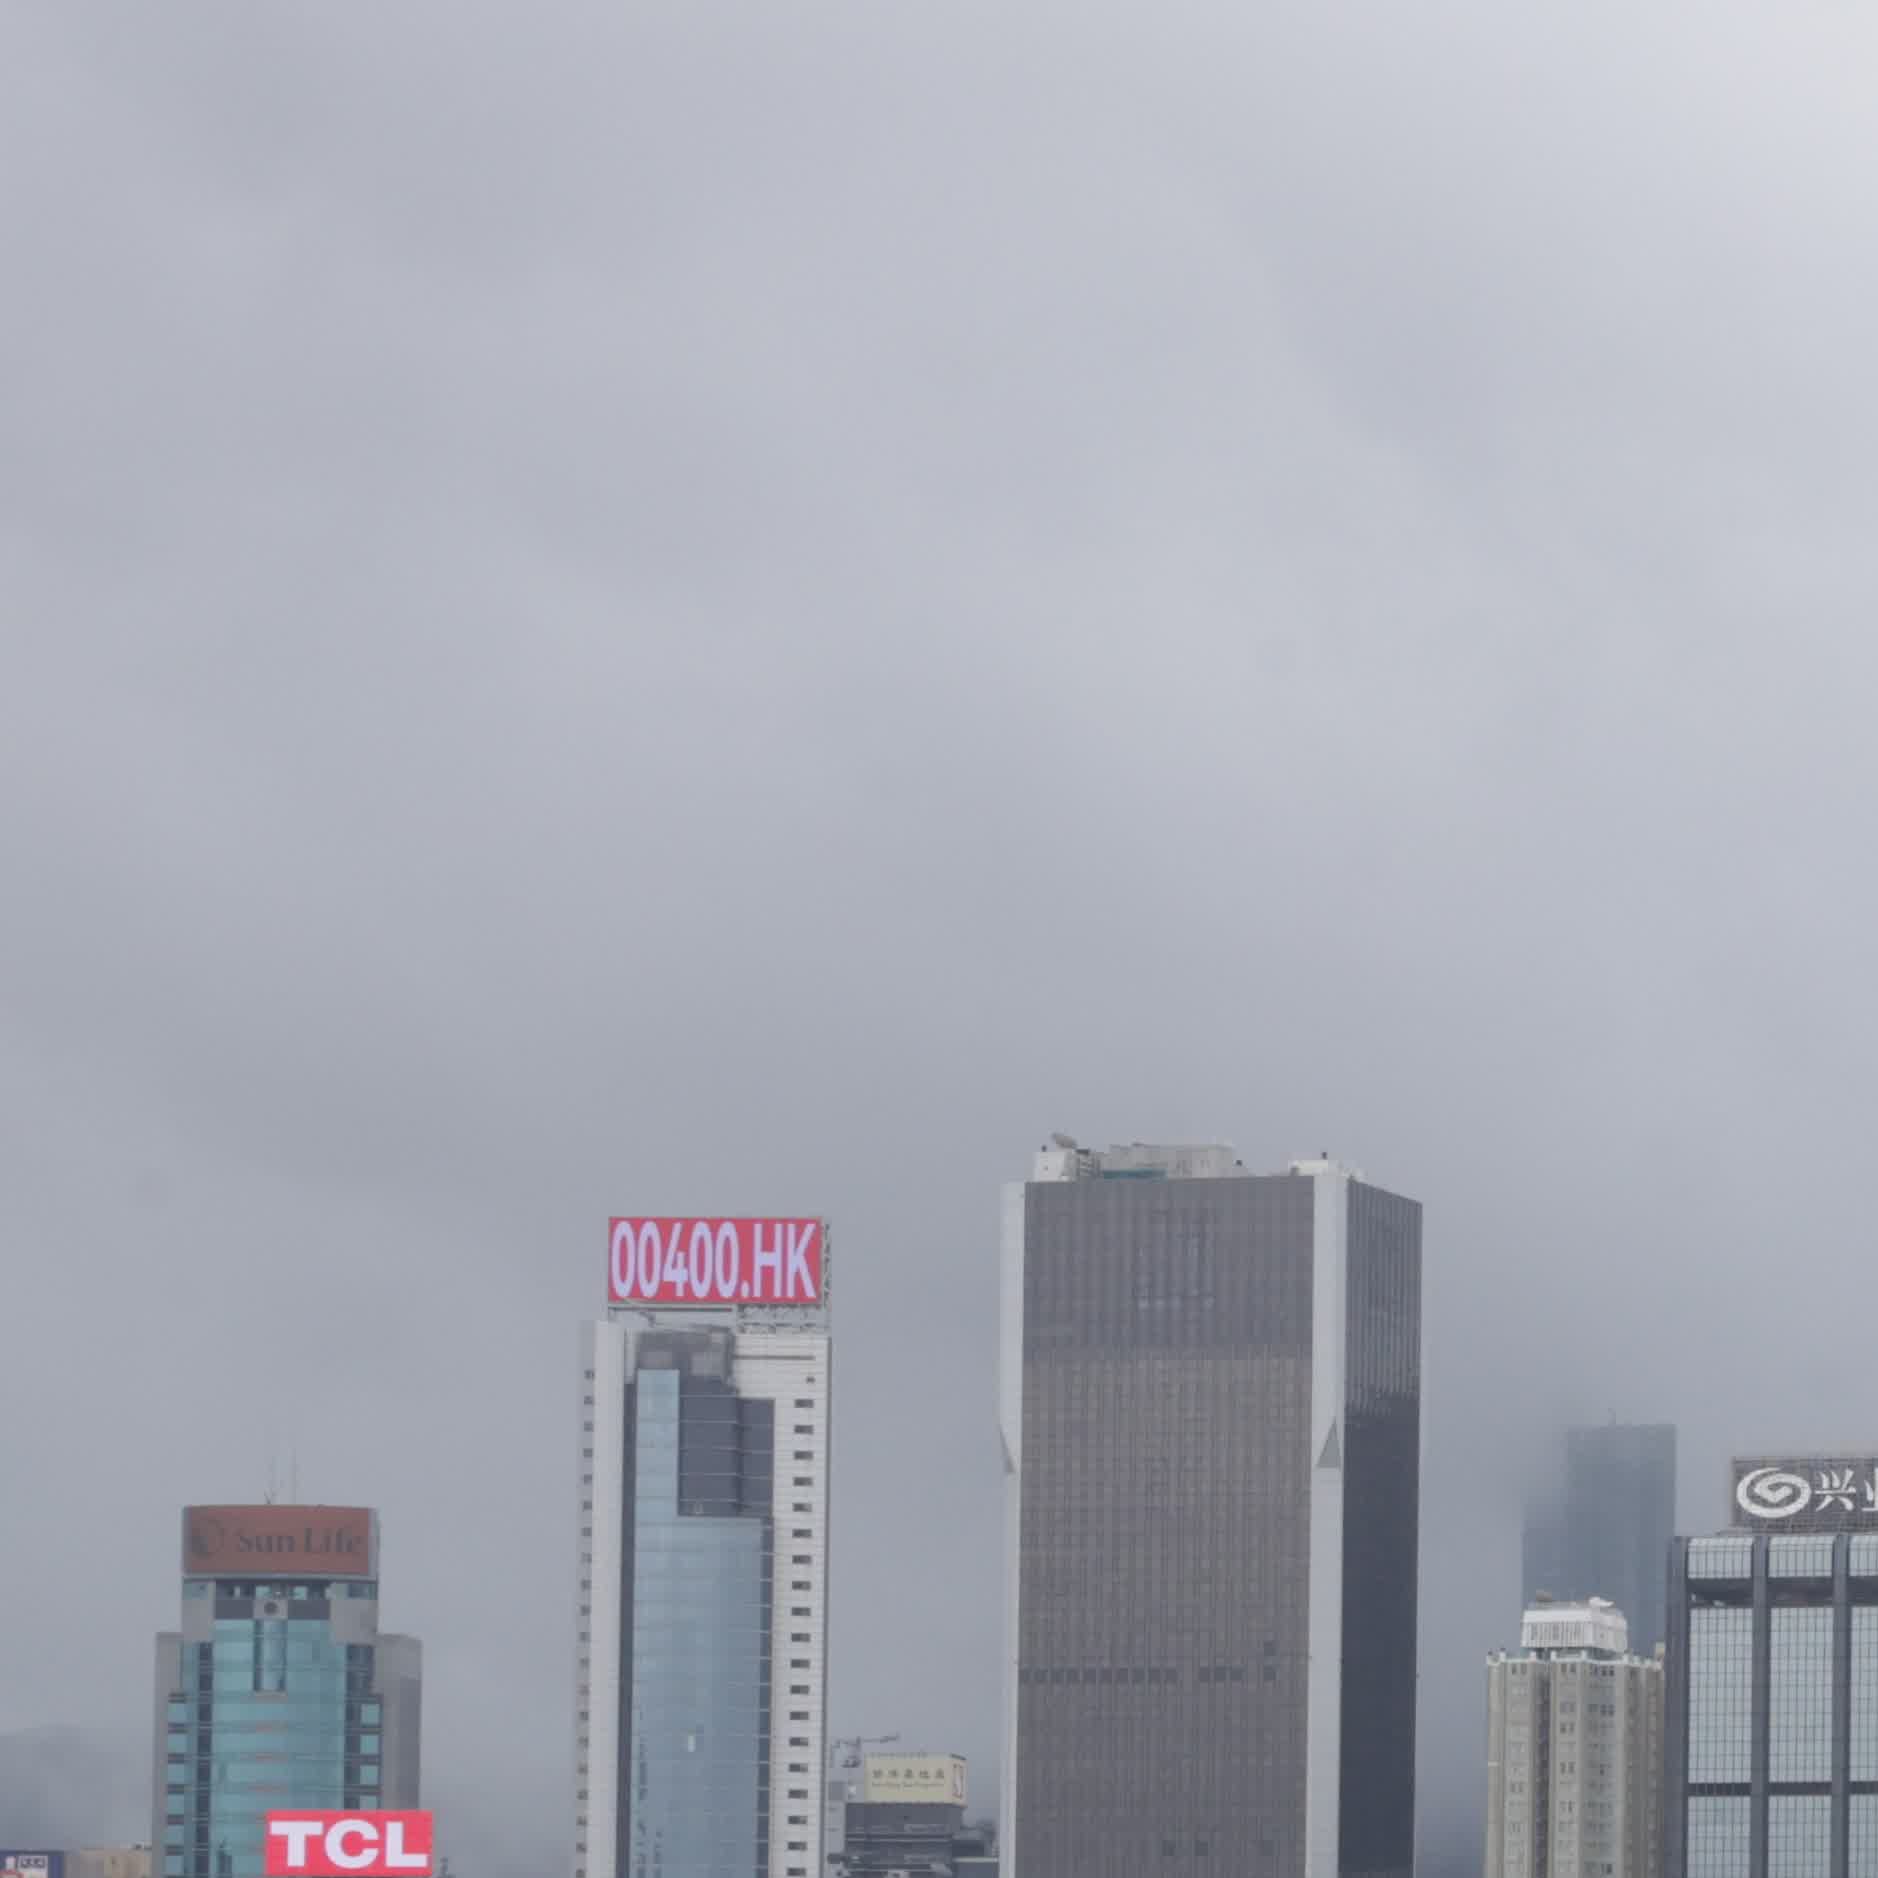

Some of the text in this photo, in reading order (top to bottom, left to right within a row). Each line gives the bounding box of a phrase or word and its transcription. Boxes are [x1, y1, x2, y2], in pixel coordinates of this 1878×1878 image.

[611, 1219, 818, 1299] 00400.HK
[235, 1525, 363, 1557] Sun Life
[269, 1818, 430, 1870] TCL
